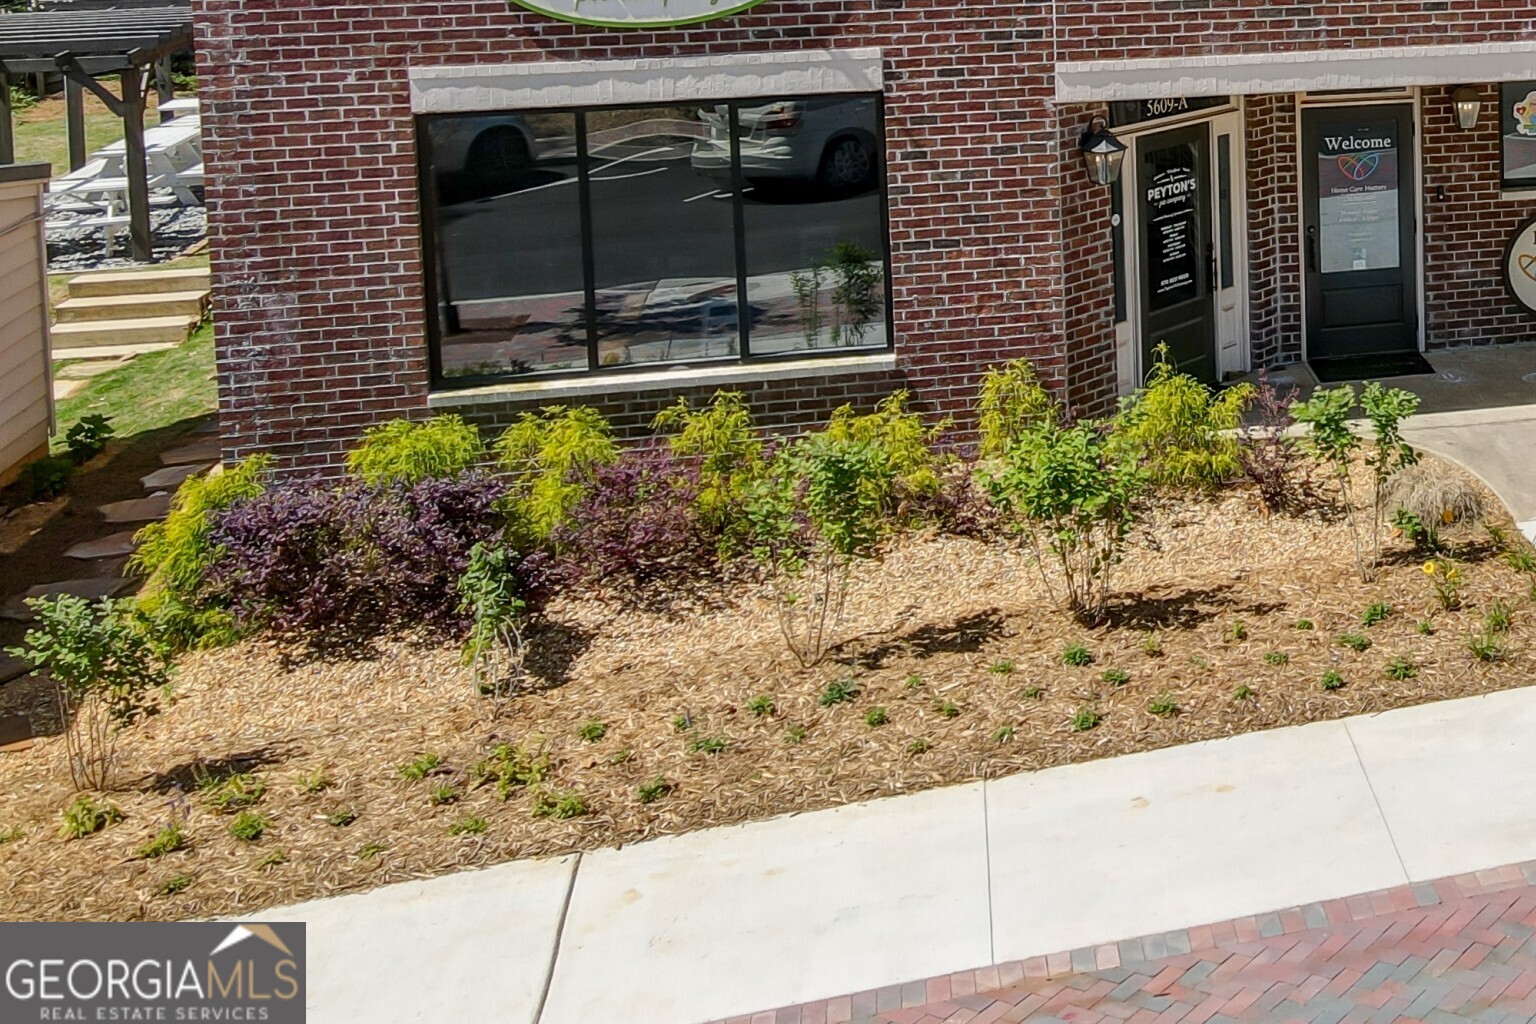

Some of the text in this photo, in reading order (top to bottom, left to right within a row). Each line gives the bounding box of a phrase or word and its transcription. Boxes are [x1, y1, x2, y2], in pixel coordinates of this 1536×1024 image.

[1146, 96, 1189, 117] 5609-A
[1324, 135, 1392, 152] Welcome
[1147, 178, 1196, 202] PEYTON'S
